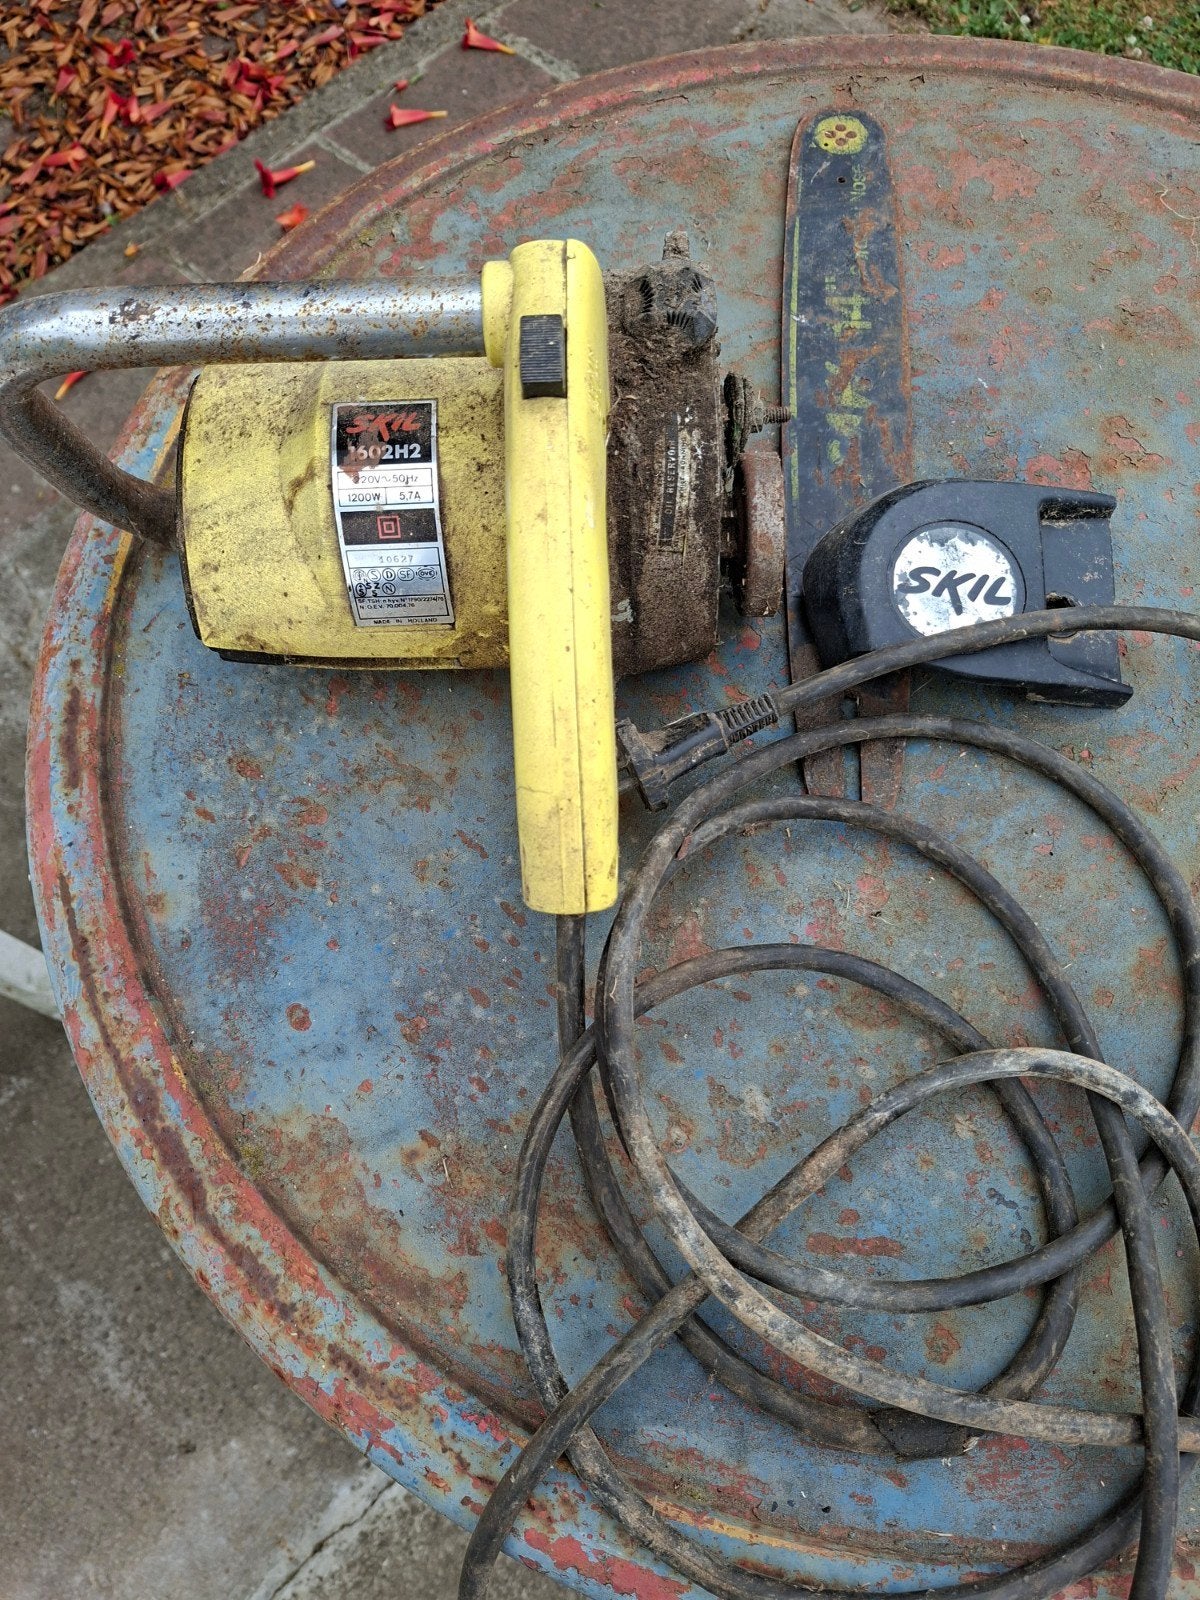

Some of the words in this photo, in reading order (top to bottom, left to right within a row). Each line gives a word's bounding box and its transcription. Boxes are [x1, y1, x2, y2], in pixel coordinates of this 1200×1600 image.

[346, 412, 421, 442] SKIL
[347, 493, 381, 503] 1200W
[399, 491, 421, 501] 5,7A
[379, 555, 414, 563] 10627
[897, 566, 1012, 616] SKIL
